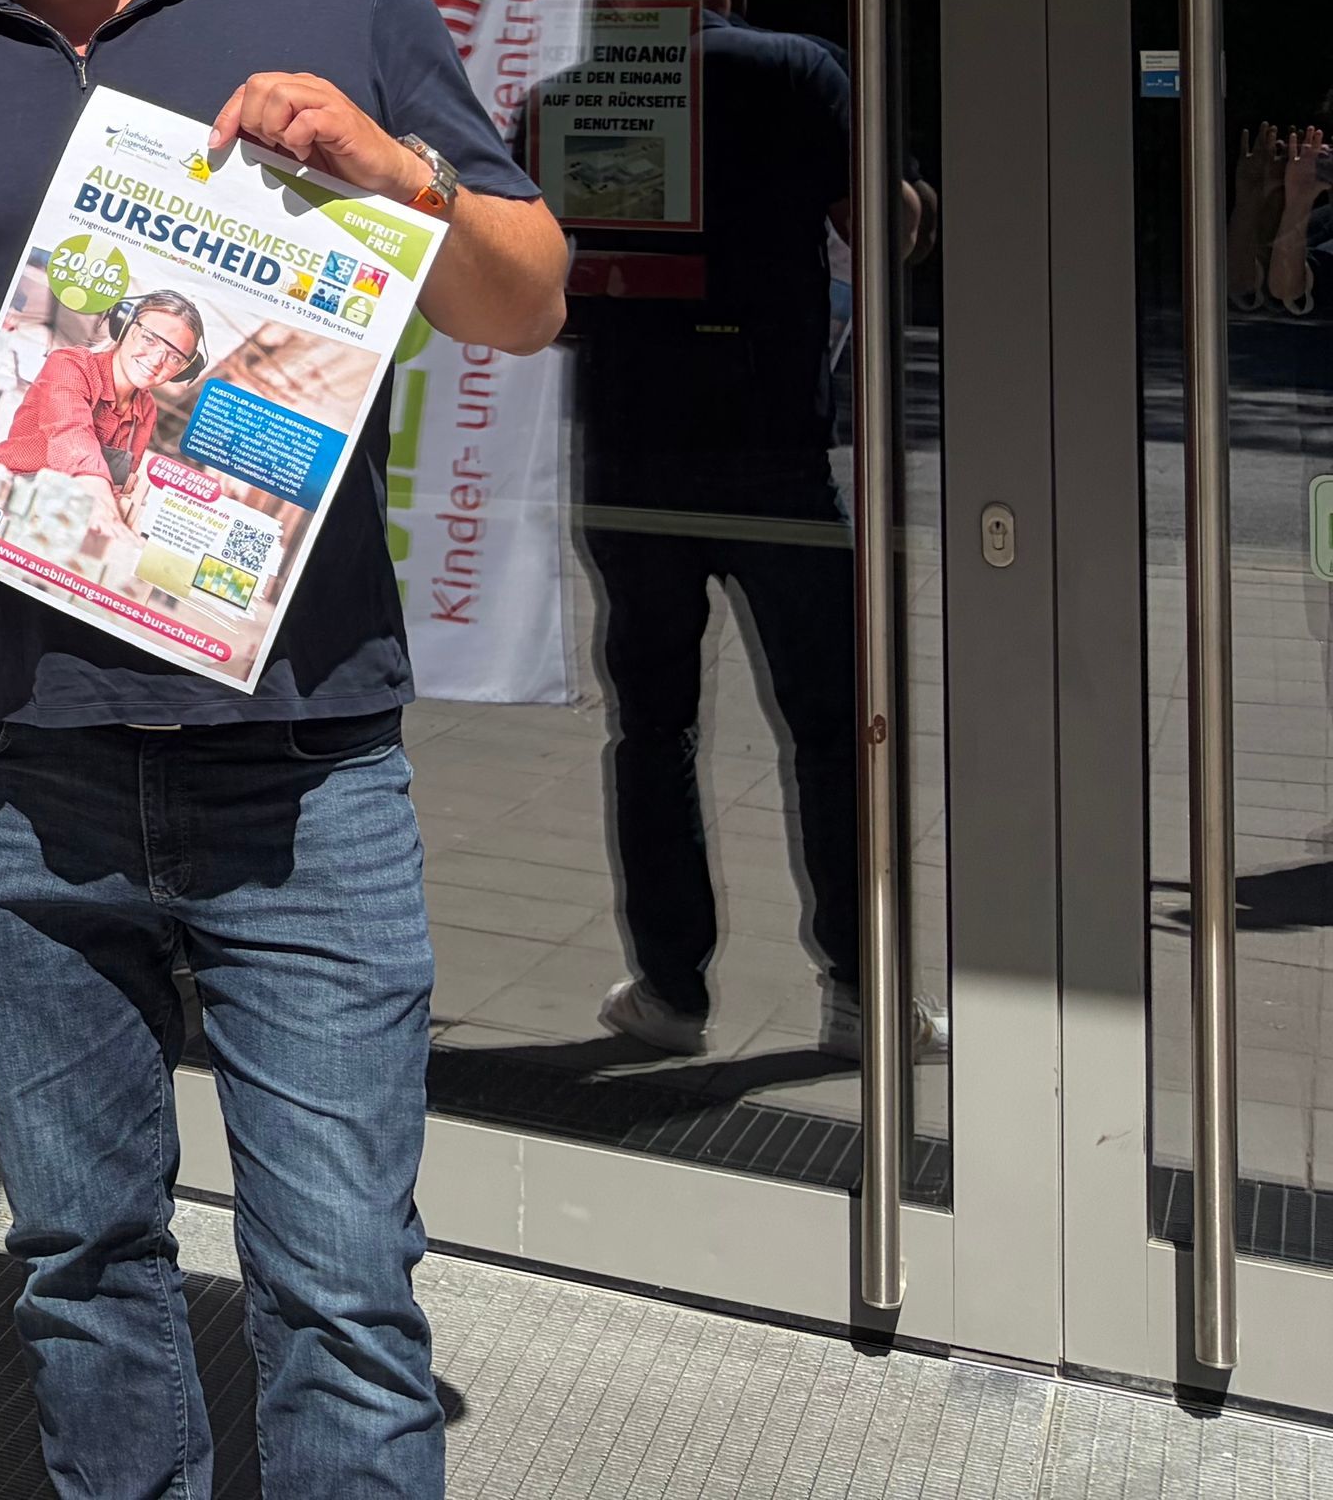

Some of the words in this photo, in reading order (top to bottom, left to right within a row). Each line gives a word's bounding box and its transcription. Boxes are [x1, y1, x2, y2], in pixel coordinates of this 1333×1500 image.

[593, 45, 687, 64] EINGANG!
[587, 71, 615, 84] DEN
[620, 71, 682, 85] EINGANG
[542, 94, 571, 107] AUF
[575, 94, 603, 107] DER
[608, 91, 687, 108] RÜCKSEITE
[573, 117, 655, 131] BENUTZEN!
[74, 183, 281, 286] BURSCHEID
[86, 164, 323, 274] AUSBILDUNGSMESSE
[343, 210, 406, 246] EINTRITT
[365, 234, 401, 258] FREI!
[52, 247, 122, 284] 20.06.
[68, 212, 80, 222] im
[79, 217, 141, 248] Jugendzentrum
[211, 272, 279, 304] Montanusstraße
[280, 299, 291, 309] 15
[296, 306, 322, 322] 51399
[321, 318, 364, 340] Burscheid
[51, 267, 68, 281] 10
[93, 280, 120, 298] Uhr
[248, 402, 263, 412] AUS
[148, 464, 213, 500] BERUFUNG
[155, 457, 186, 476] FINDE
[185, 471, 218, 492] DEINE
[162, 497, 205, 520] MacBook
